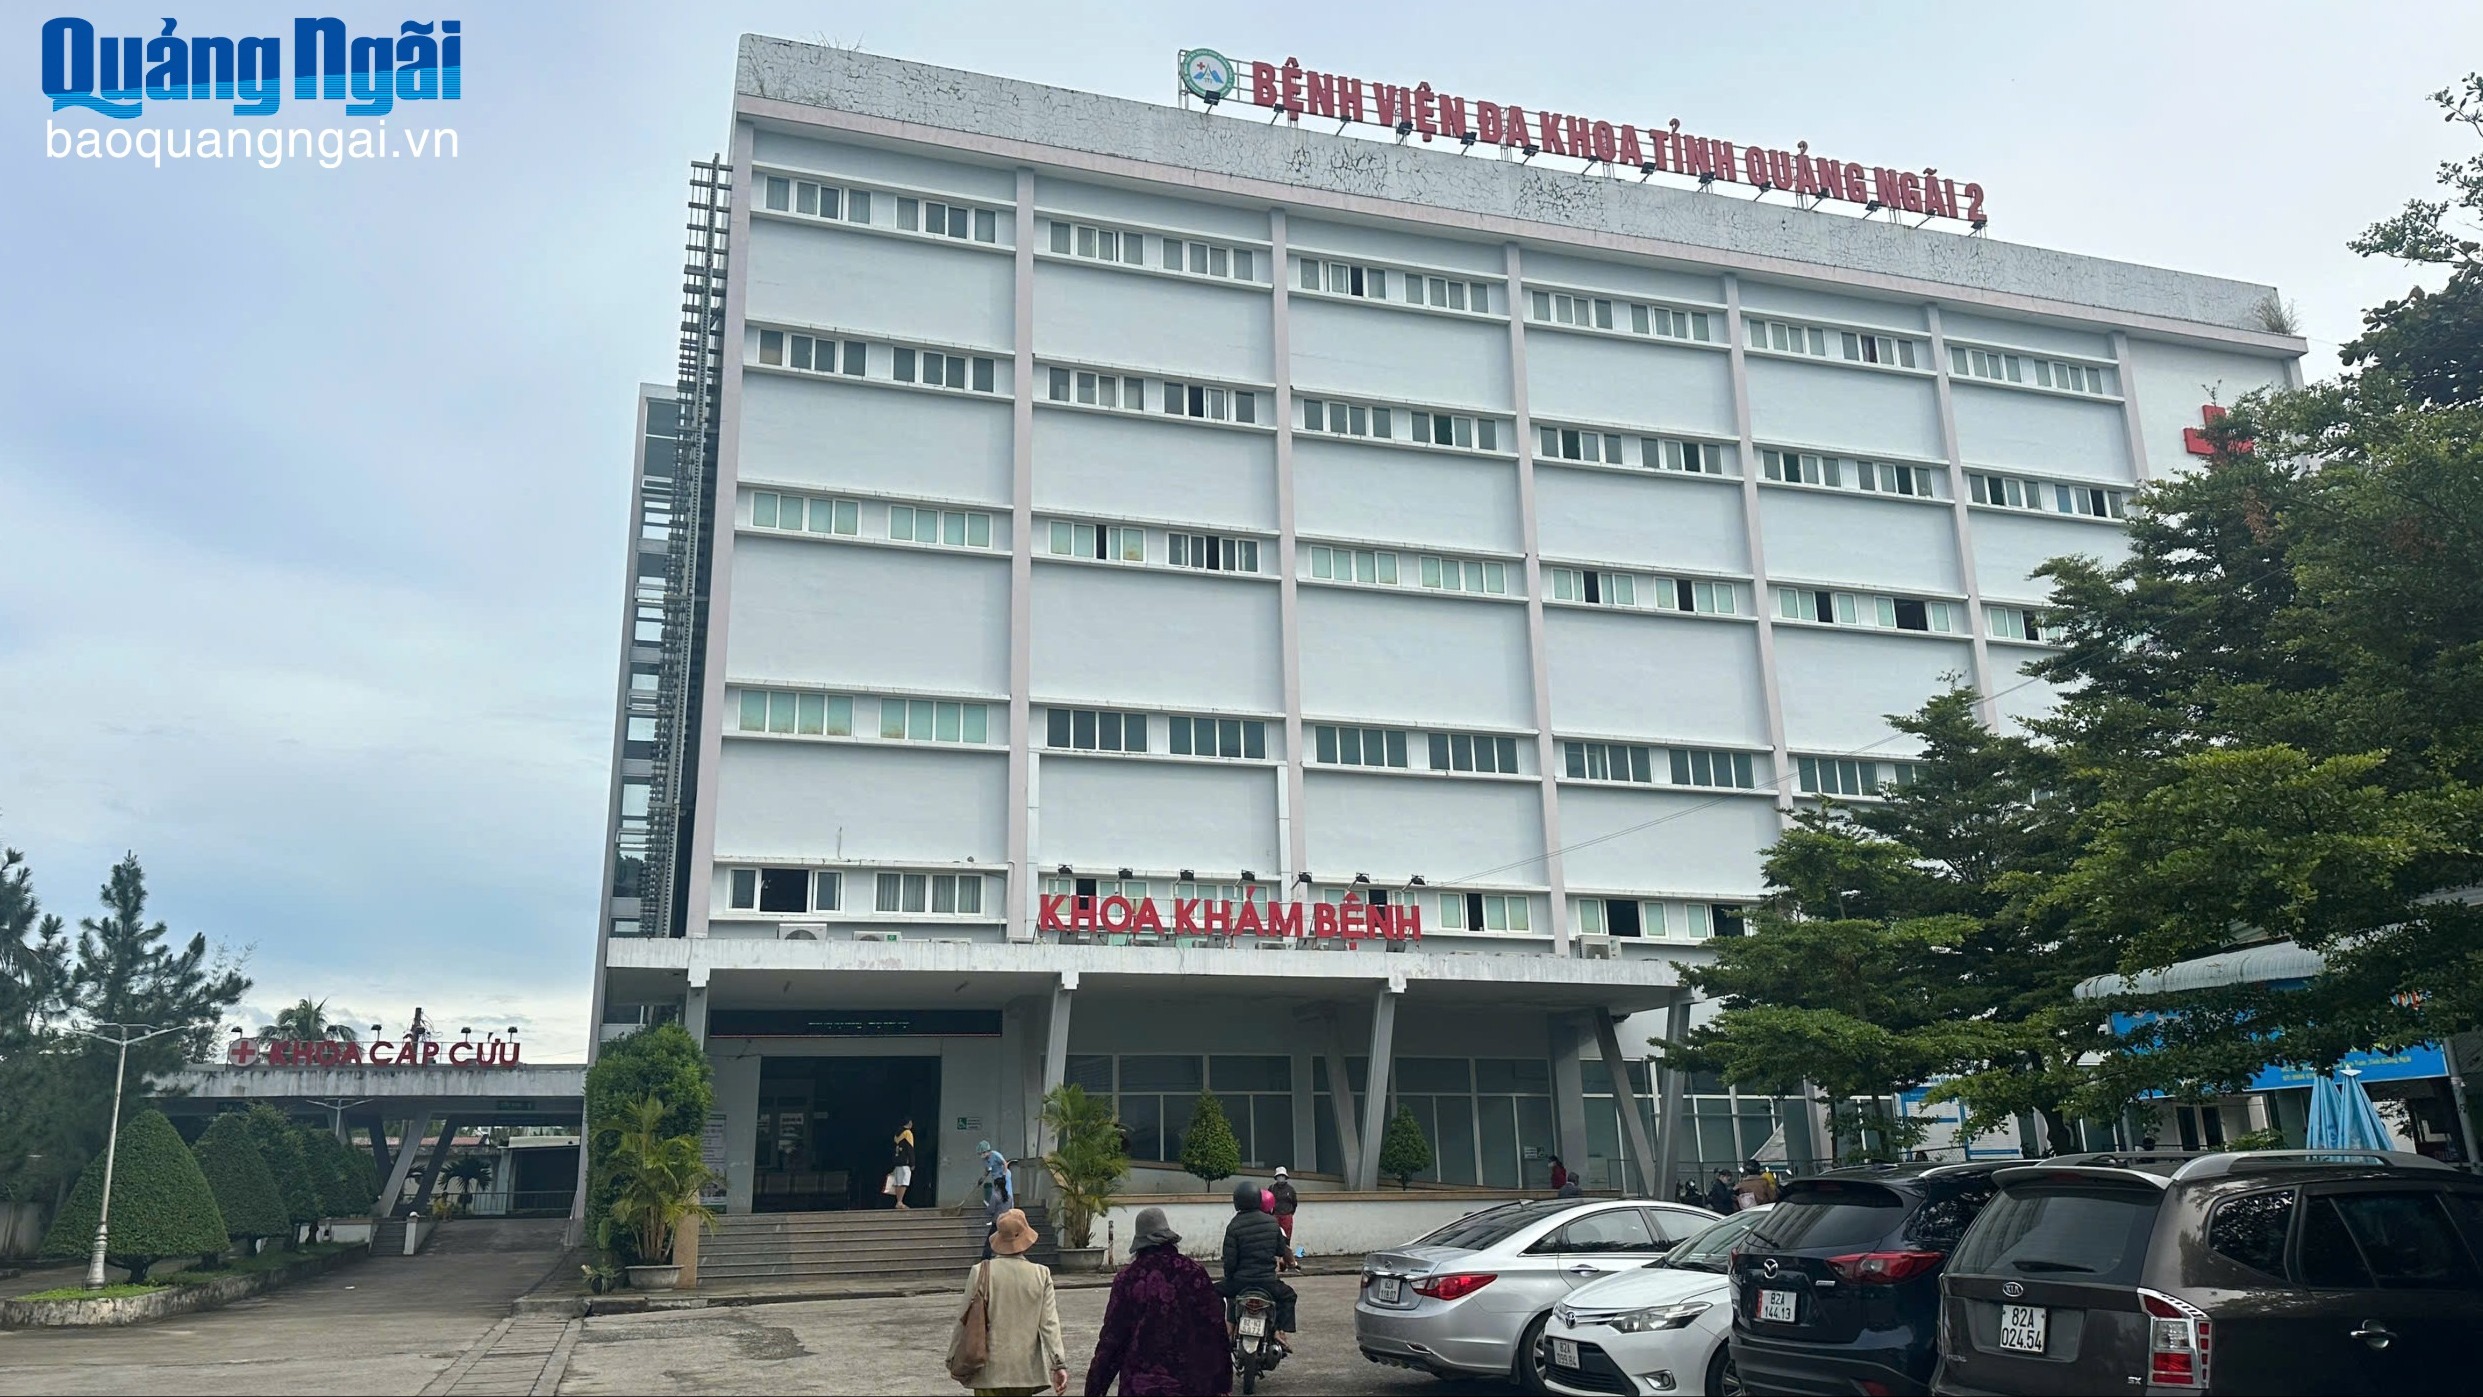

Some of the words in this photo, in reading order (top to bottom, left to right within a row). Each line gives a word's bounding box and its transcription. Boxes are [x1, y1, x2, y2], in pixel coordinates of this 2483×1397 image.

[1252, 57, 1363, 122] BỆNH
[1373, 82, 1467, 143] VIỆN
[1477, 101, 1530, 149] ĐA
[1540, 110, 1644, 168] KHOA
[1649, 118, 1737, 182] TỈNH
[1745, 140, 1868, 204] QUẢNG
[1874, 168, 1959, 219] NGÃI
[1965, 182, 1987, 222] 2
[1039, 894, 1165, 935] KHOA
[1174, 885, 1303, 938] KHÁM
[1314, 892, 1421, 951] BỆNH
[268, 1040, 363, 1067] KHOA
[449, 1032, 520, 1068] CỨU
[1770, 1292, 1785, 1305] 82A
[1765, 1306, 1791, 1319] 144.13
[2012, 1307, 2034, 1328] 82A
[2001, 1327, 2042, 1350] 024.54
